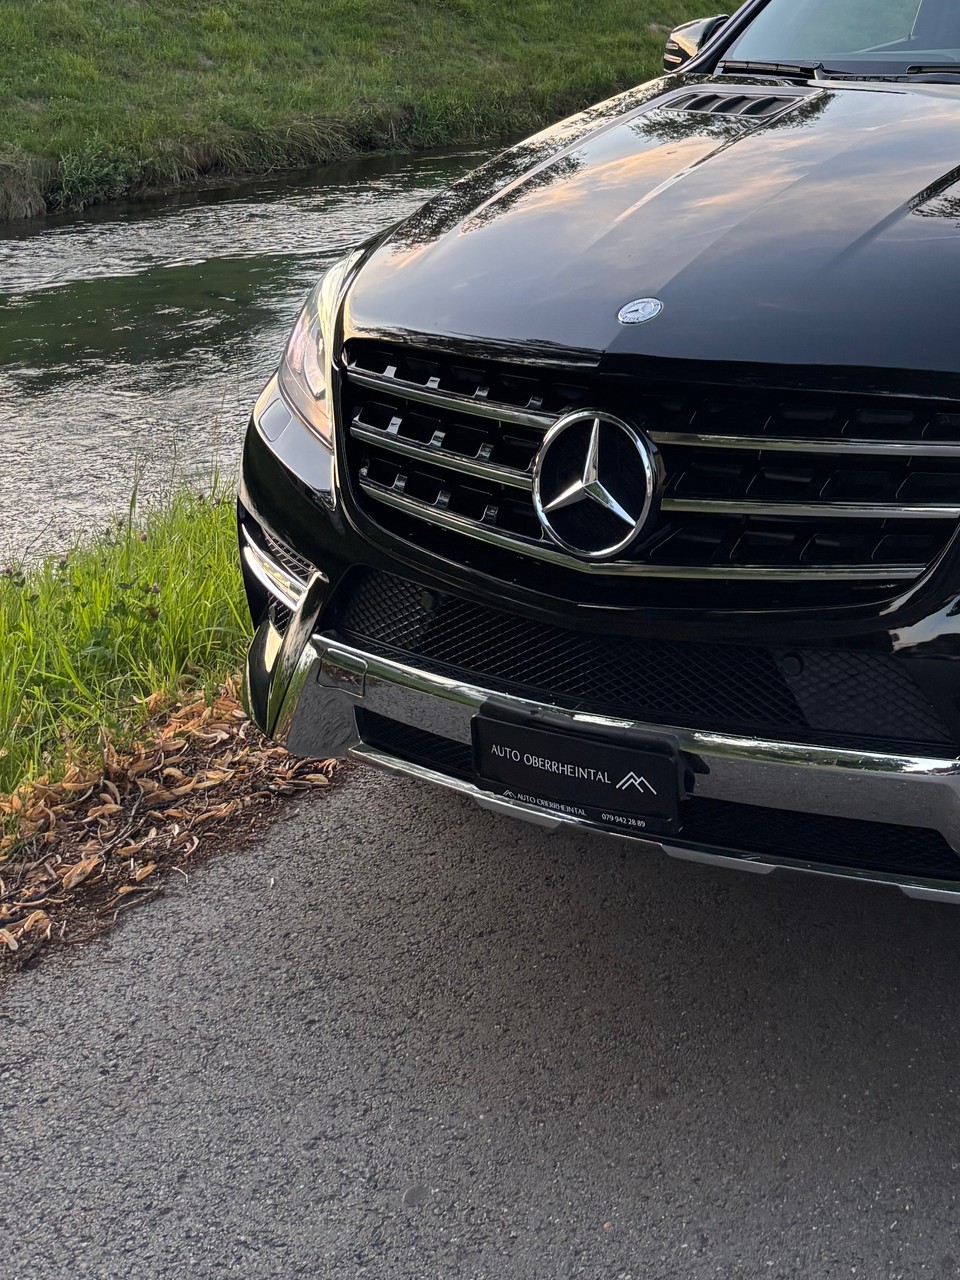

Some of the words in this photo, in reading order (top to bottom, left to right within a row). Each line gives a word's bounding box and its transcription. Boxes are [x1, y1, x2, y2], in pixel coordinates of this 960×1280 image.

[491, 744, 520, 762] AUTO
[523, 753, 612, 784] OBERRHEINTAL
[517, 793, 536, 803] AUTO
[536, 798, 587, 816] OBERRHEINTAL
[601, 813, 614, 821] 079
[614, 816, 627, 824] 942
[627, 818, 637, 826] 28
